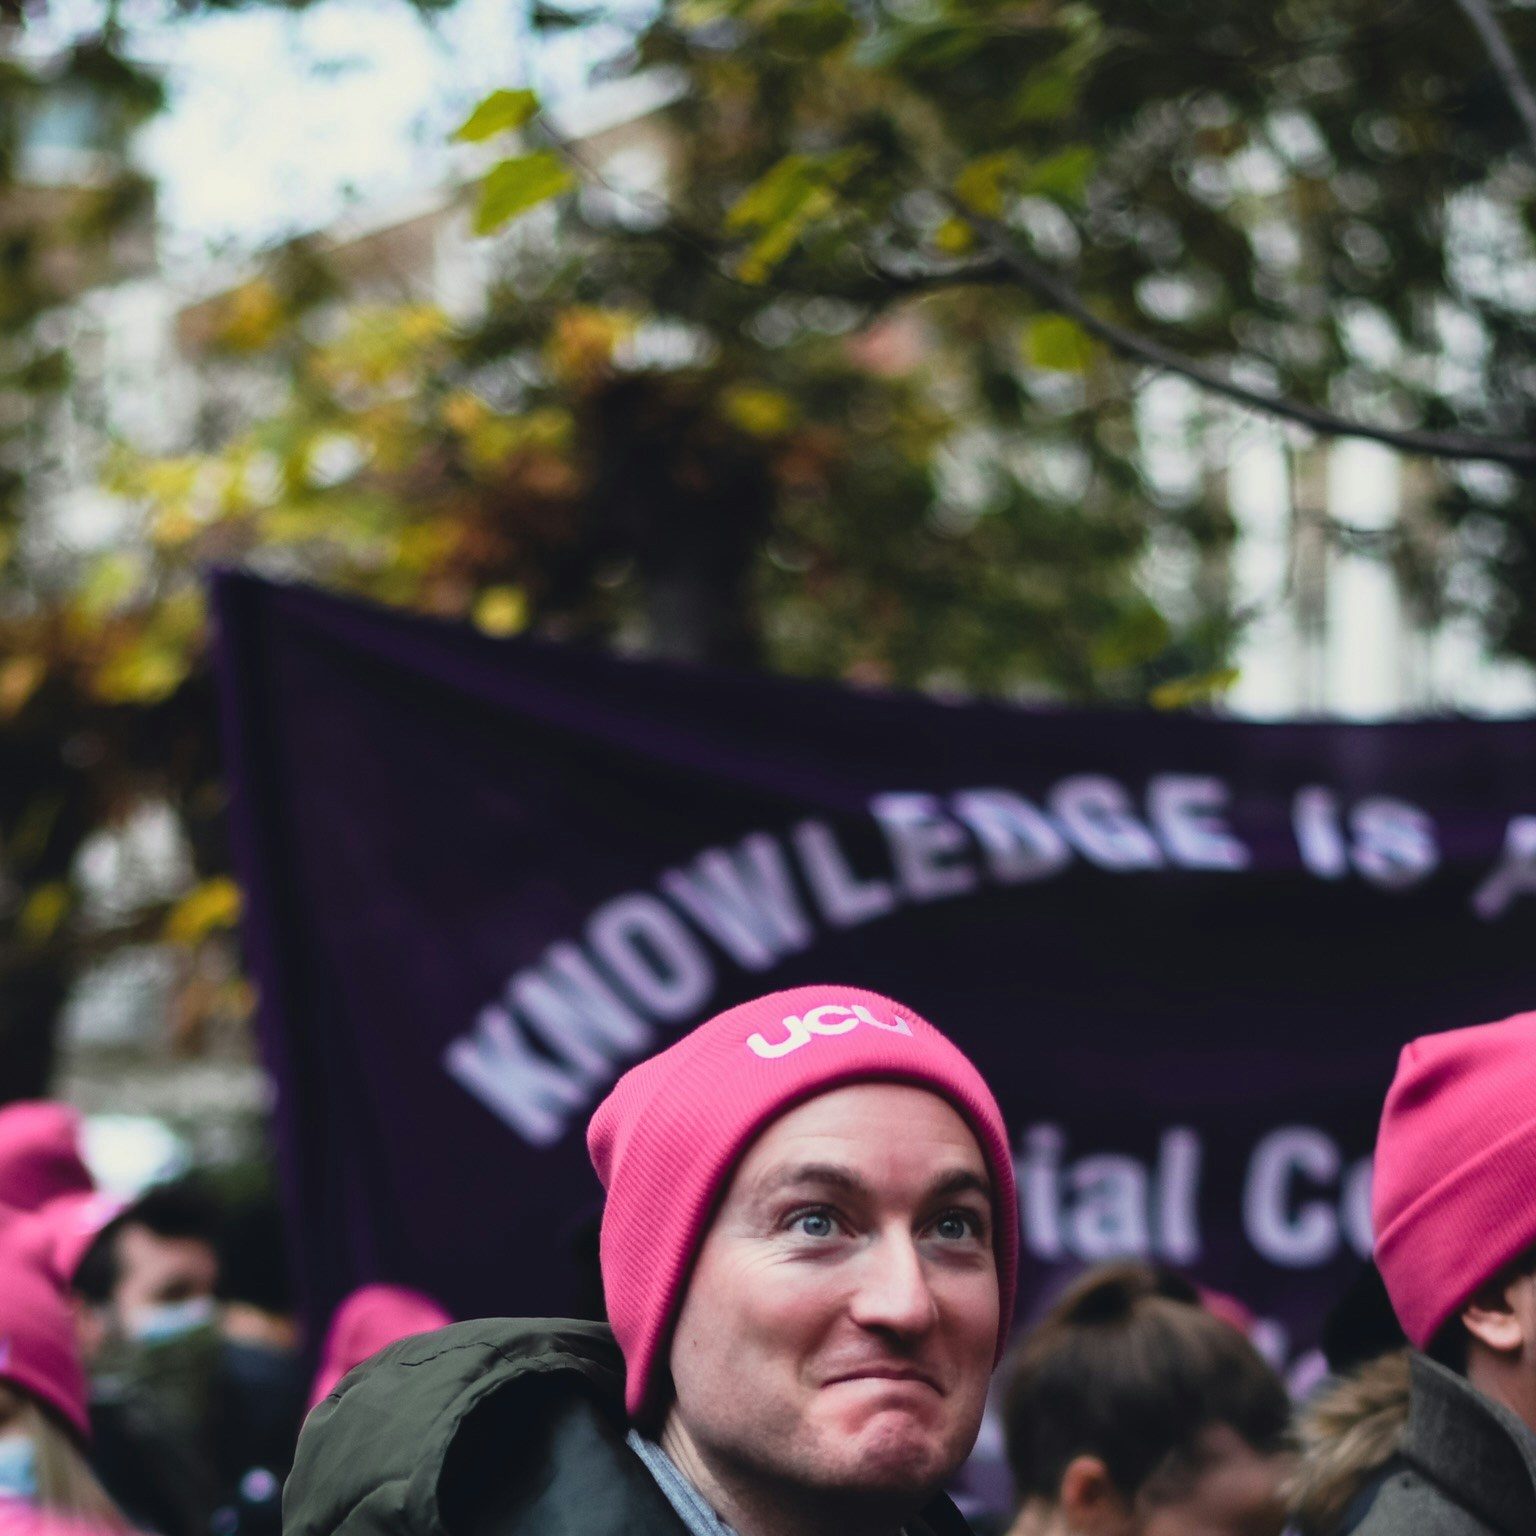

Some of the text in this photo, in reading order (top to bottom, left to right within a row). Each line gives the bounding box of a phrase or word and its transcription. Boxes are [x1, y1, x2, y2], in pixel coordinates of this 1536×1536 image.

[446, 775, 1250, 1146] KNOWLEDGE
[1291, 786, 1440, 888] IS
[746, 1004, 914, 1060] UCU
[1019, 1123, 1201, 1265] ial
